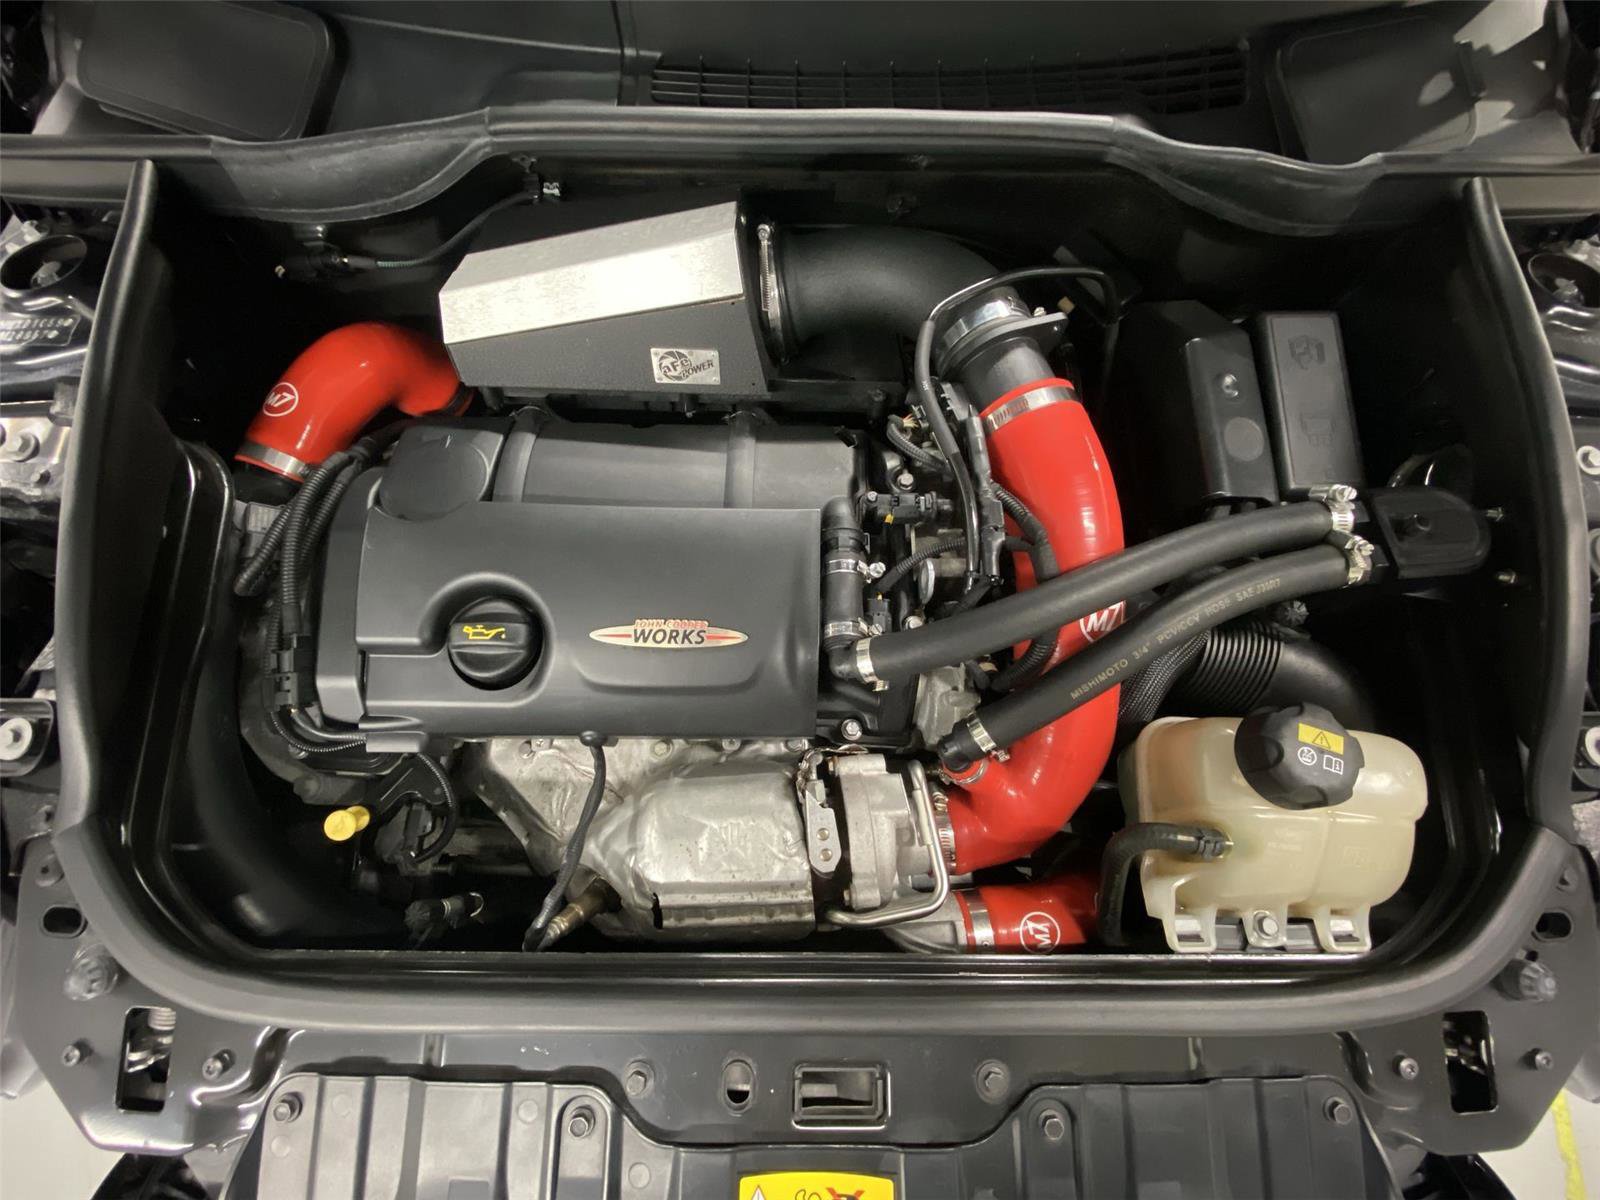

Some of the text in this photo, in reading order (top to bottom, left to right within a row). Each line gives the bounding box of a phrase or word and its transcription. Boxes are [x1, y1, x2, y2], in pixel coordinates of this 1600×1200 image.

[681, 360, 714, 378] POWER
[634, 619, 663, 629] JOHN
[633, 628, 706, 645] WORKS
[1070, 658, 1128, 700] MISHIMOTO
